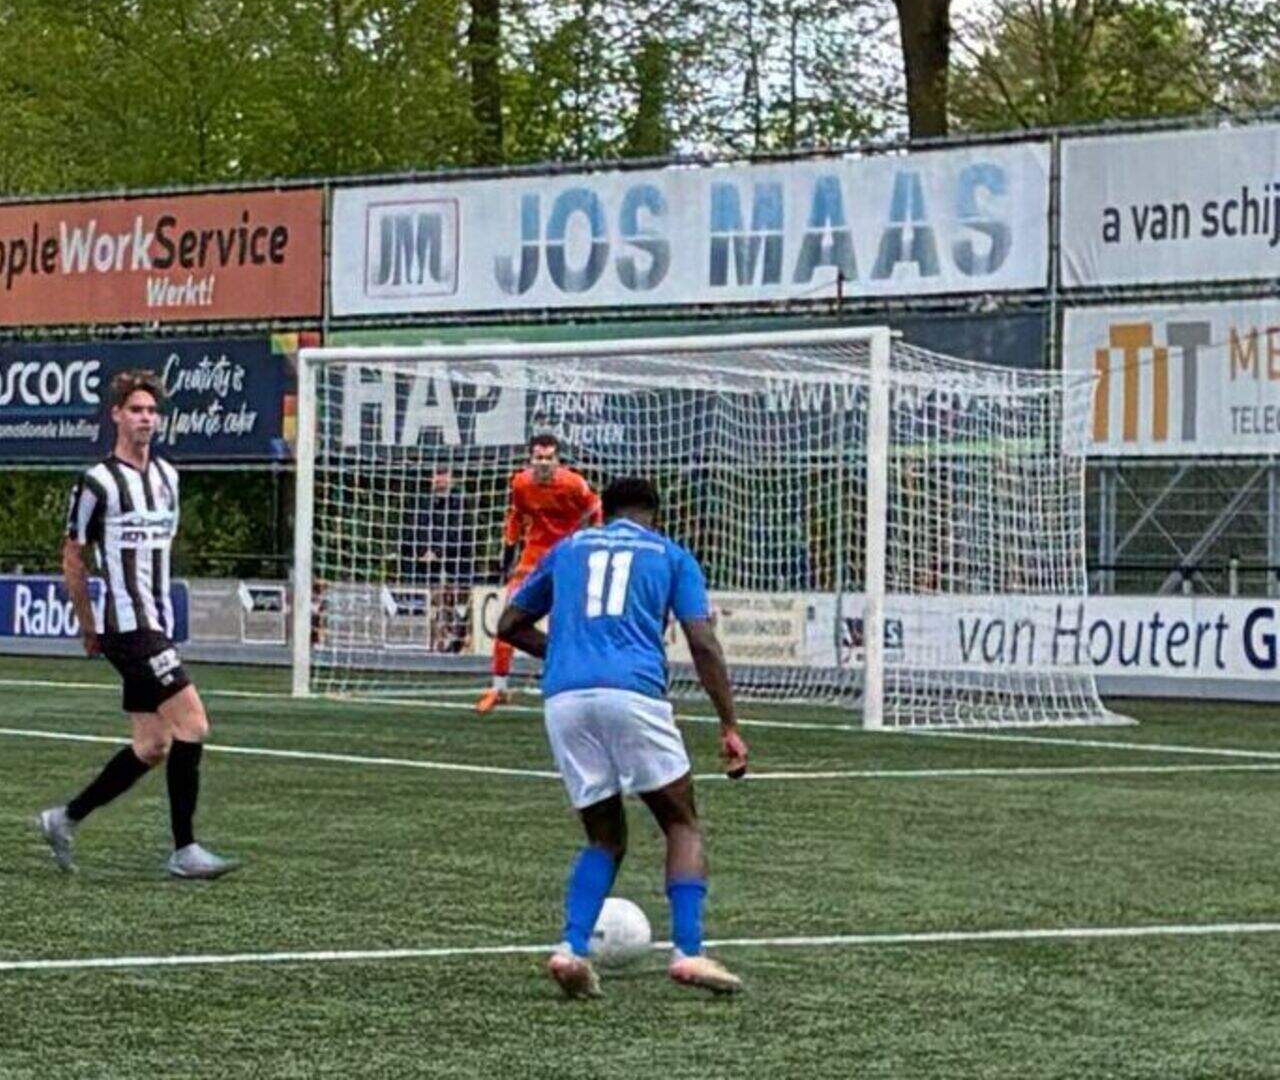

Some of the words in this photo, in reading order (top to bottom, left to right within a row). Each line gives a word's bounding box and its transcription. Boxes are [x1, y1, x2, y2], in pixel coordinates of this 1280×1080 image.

[494, 183, 671, 296] JOS
[708, 161, 1013, 288] MAAS
[1102, 206, 1121, 243] a
[1131, 201, 1190, 241] van
[146, 274, 215, 308] Werkt!
[586, 549, 635, 618] 11
[957, 618, 1036, 665] van
[1051, 603, 1228, 669] Houtert
